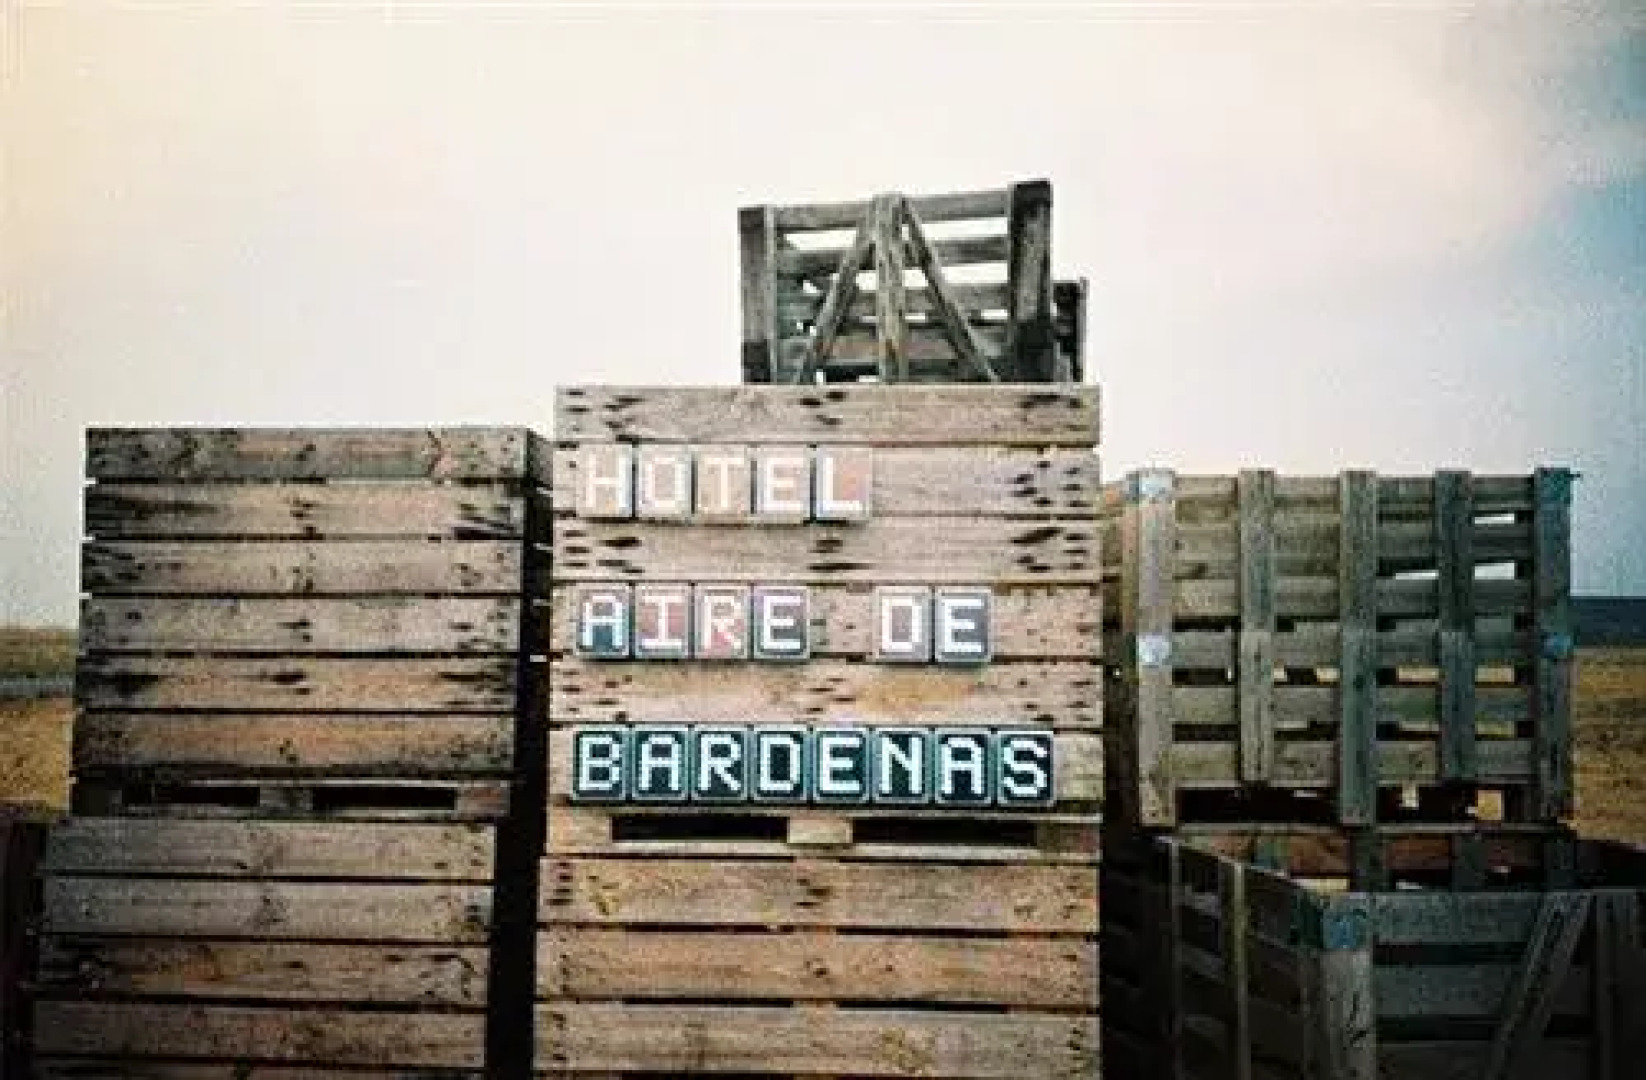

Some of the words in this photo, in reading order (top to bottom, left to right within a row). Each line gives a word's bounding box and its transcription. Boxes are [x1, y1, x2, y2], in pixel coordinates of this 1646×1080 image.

[583, 455, 867, 509] HOTEL
[581, 595, 802, 651] AIRE
[881, 597, 985, 653] DE
[577, 733, 1048, 797] BARDENAS
